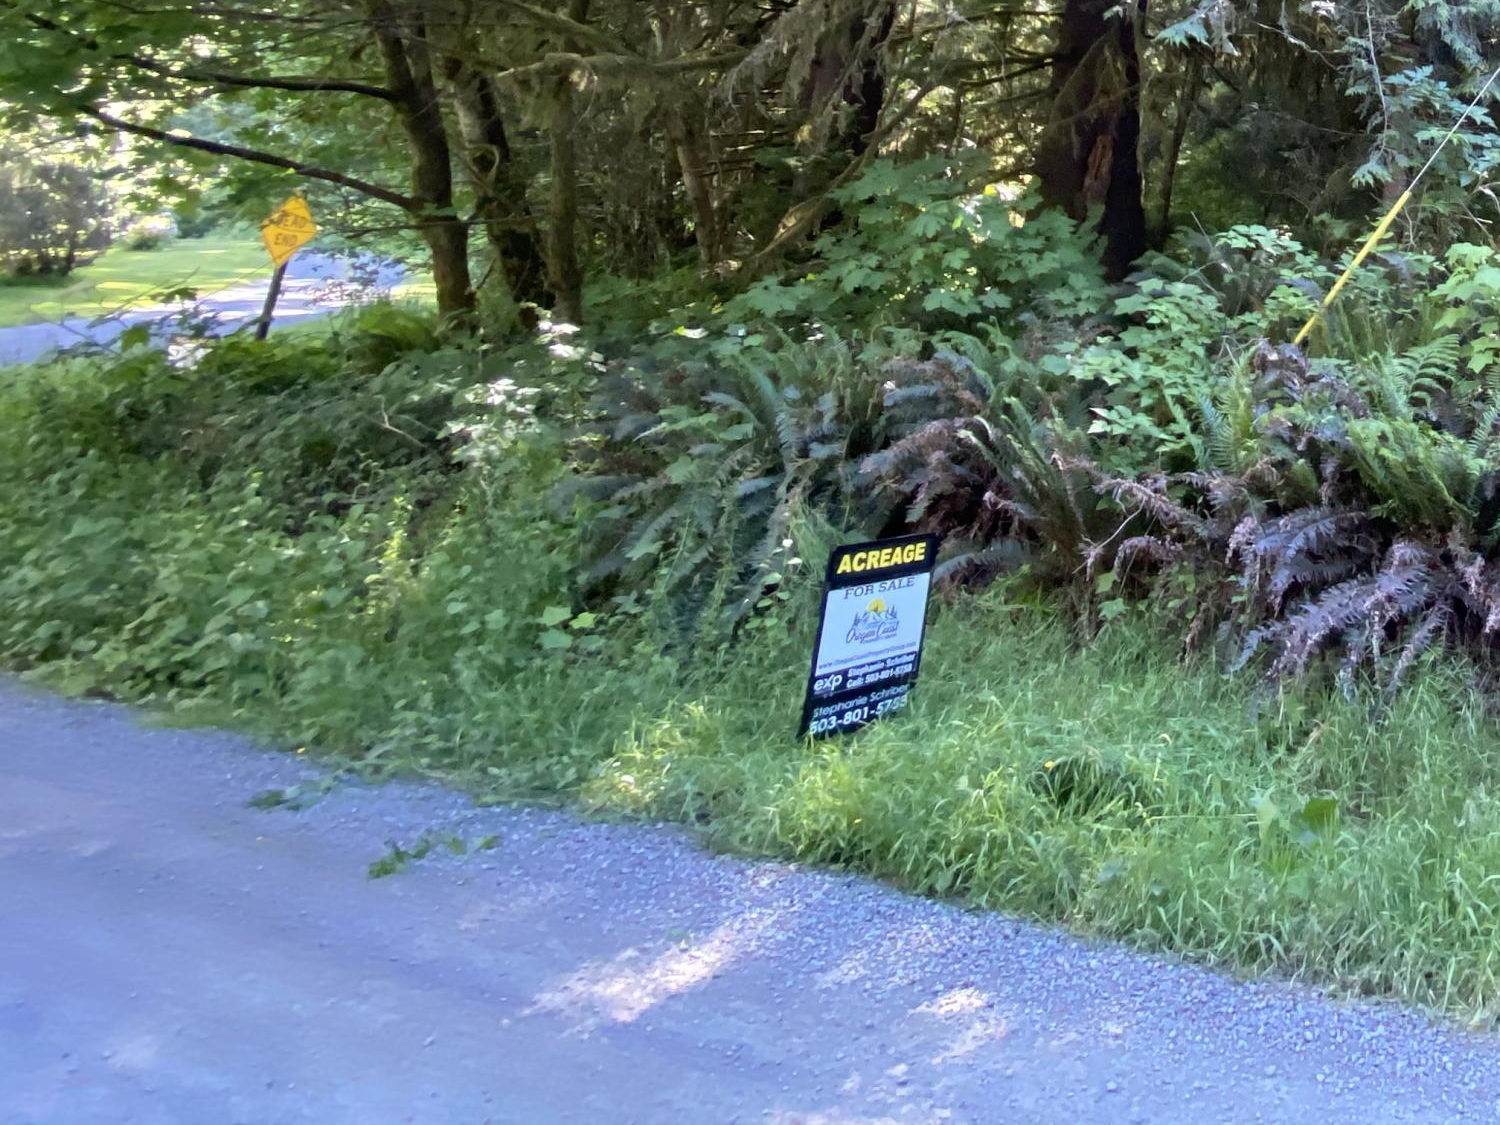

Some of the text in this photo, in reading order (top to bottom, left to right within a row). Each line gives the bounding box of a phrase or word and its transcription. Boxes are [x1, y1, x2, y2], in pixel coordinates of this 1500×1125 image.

[275, 233, 298, 246] END
[836, 542, 927, 574] ACREAGE
[843, 576, 915, 600] FOR SALE
[813, 695, 868, 718] Stephanie
